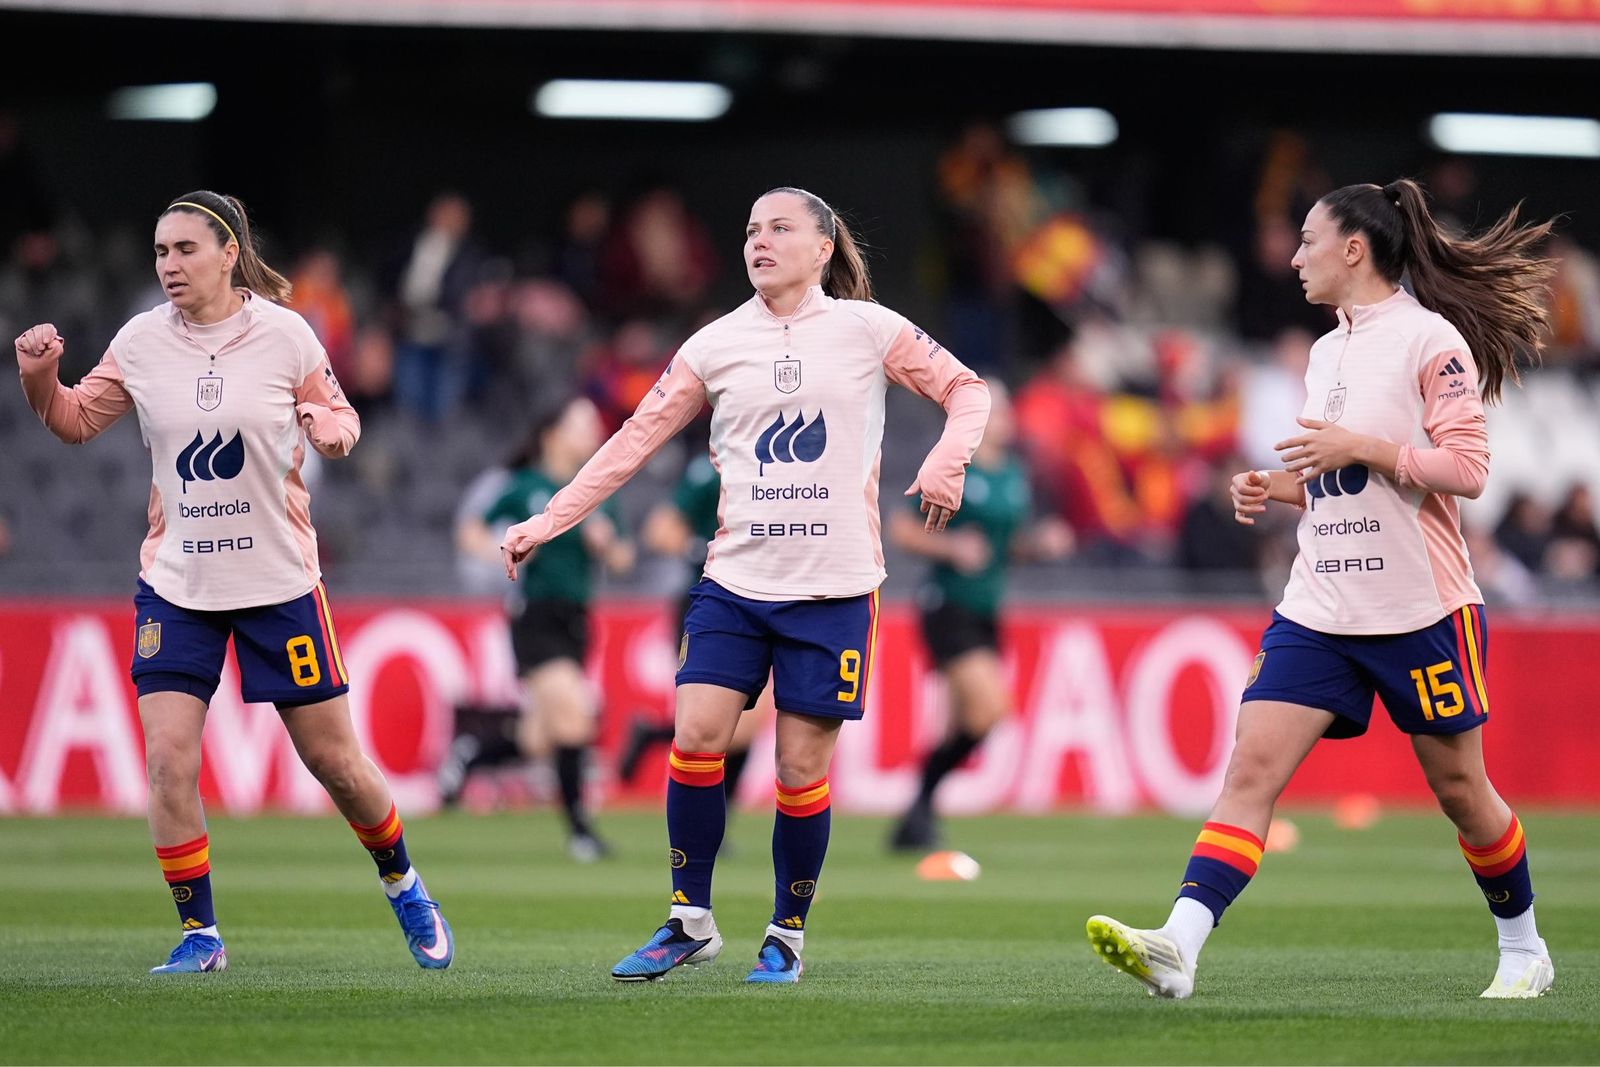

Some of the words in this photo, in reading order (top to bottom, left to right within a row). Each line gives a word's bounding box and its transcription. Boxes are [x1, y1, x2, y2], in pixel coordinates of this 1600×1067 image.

[752, 483, 829, 501] Iberdrola
[179, 499, 251, 518] Iberdrola
[751, 523, 828, 537] EBRO
[183, 537, 253, 553] EBRO
[1315, 557, 1384, 573] EBRO
[286, 635, 321, 687] 8
[837, 649, 861, 703] 9
[1409, 659, 1465, 721] 15
